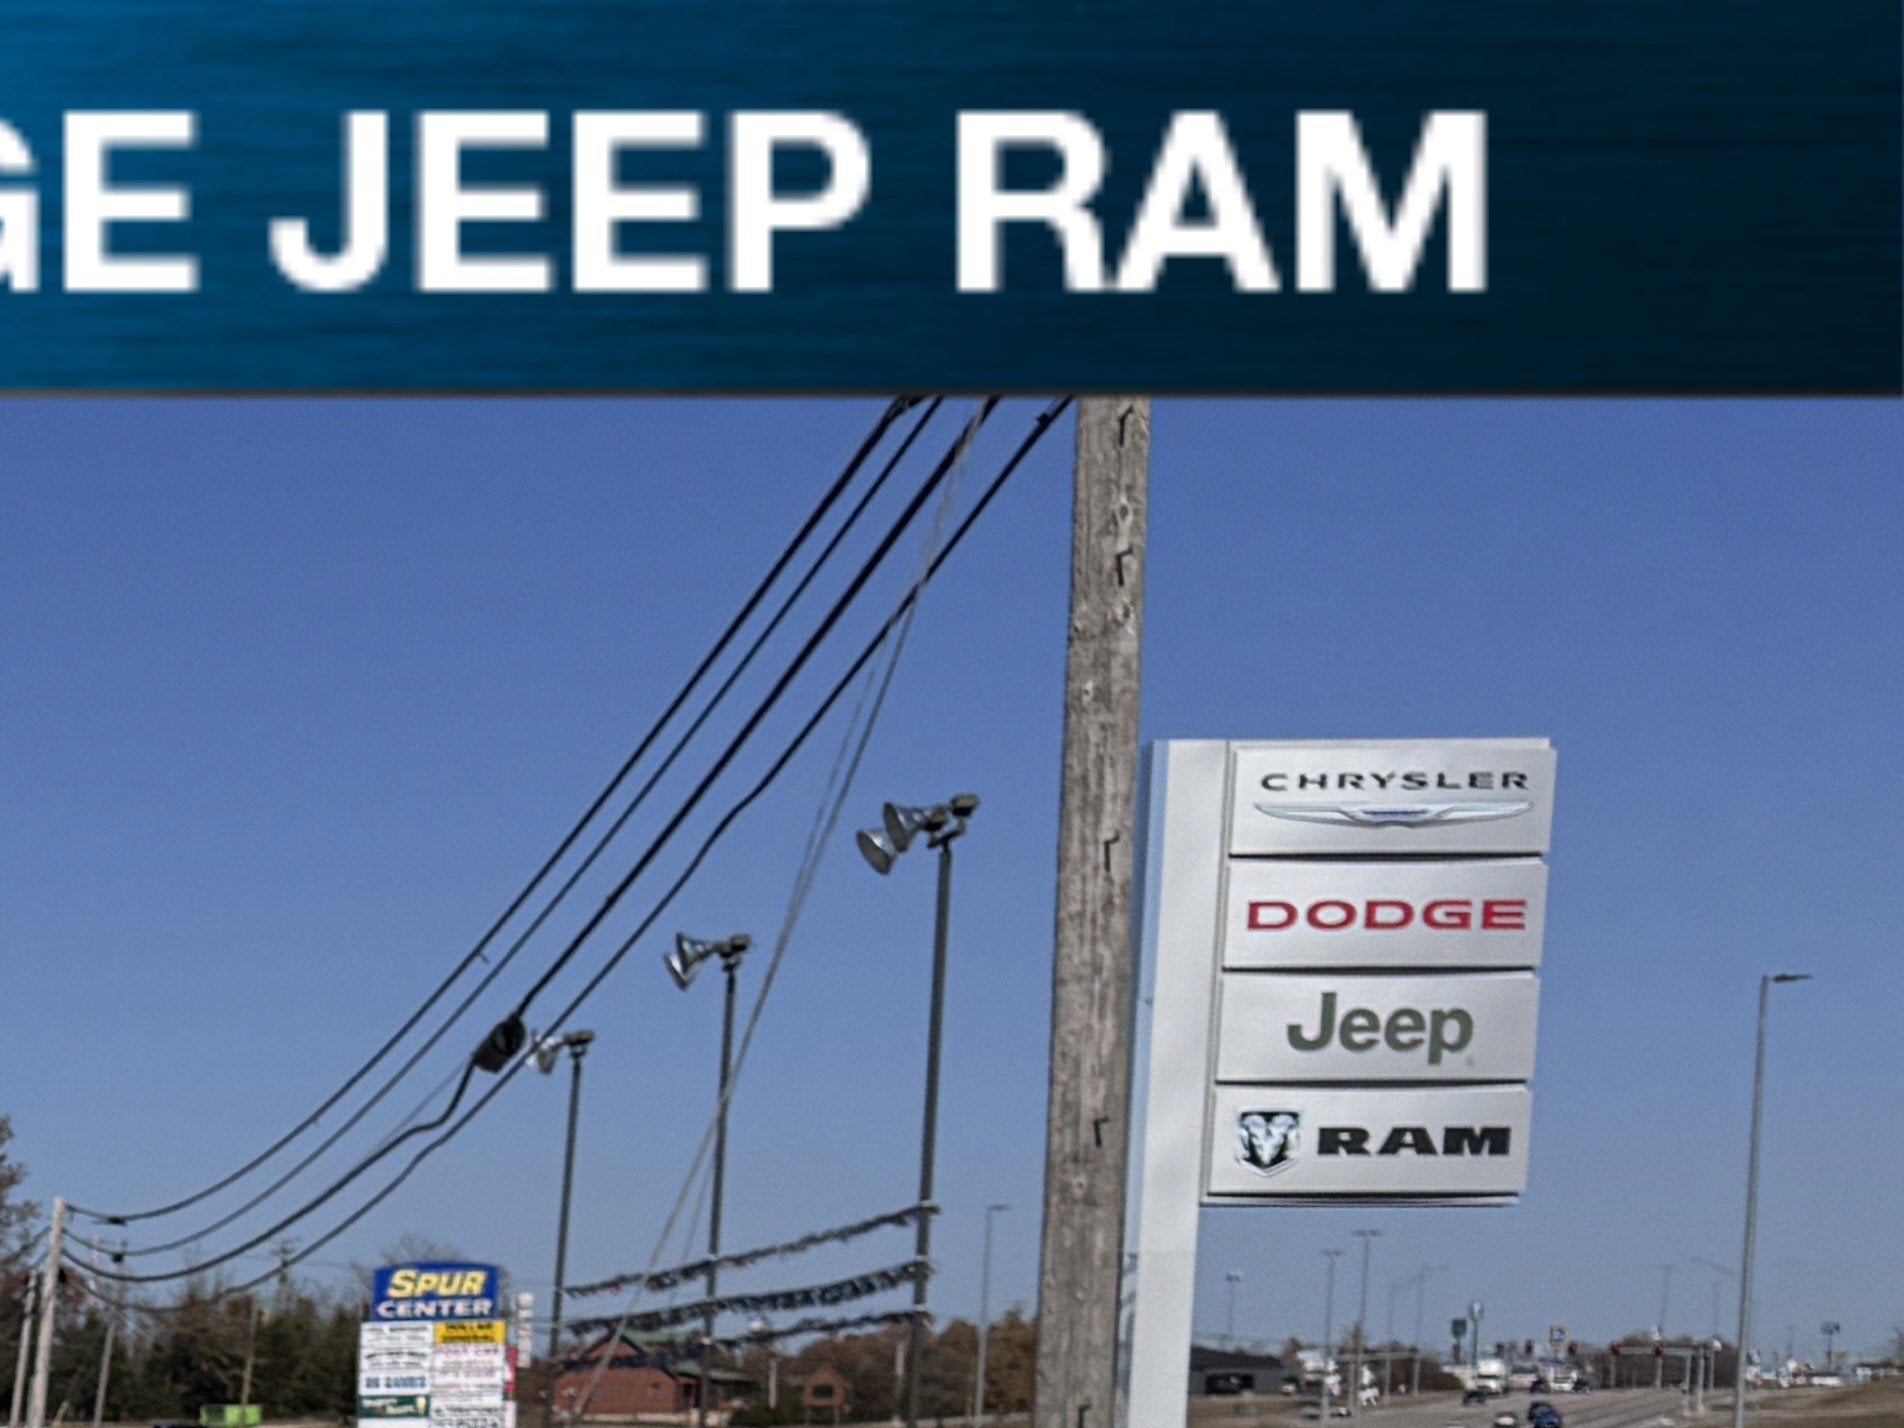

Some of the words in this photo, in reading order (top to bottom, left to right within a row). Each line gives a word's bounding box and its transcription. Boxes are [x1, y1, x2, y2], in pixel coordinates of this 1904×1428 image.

[1260, 770, 1531, 792] CHRYSLER
[1246, 898, 1527, 932] DODGE
[1286, 990, 1475, 1067] Jeep
[1317, 1126, 1512, 1157] RAM
[386, 1267, 489, 1299] SPUR
[376, 1299, 493, 1319] CENTER
